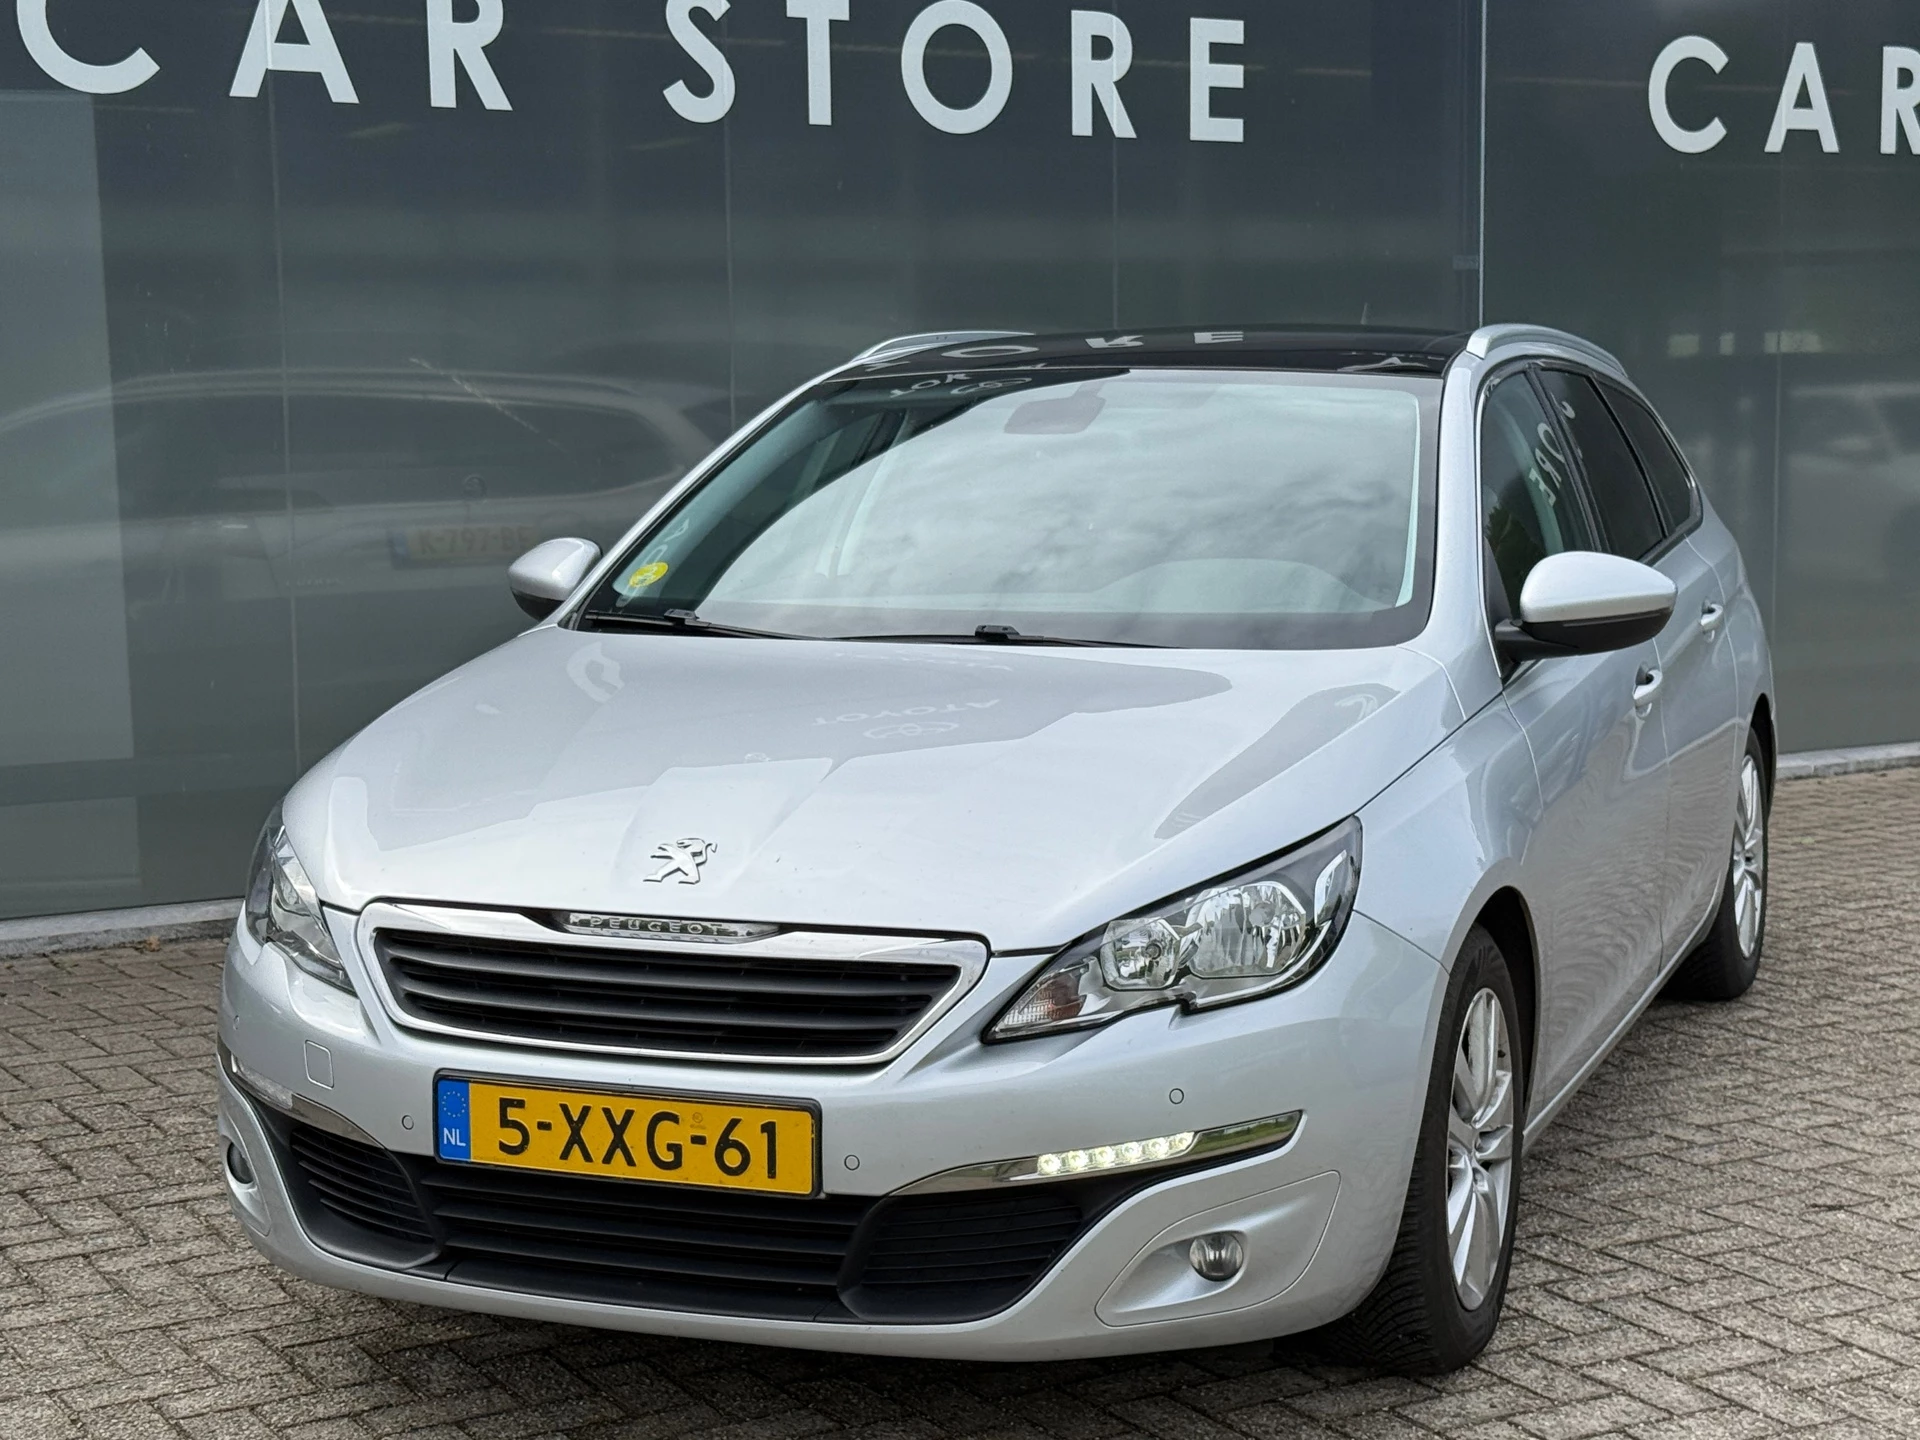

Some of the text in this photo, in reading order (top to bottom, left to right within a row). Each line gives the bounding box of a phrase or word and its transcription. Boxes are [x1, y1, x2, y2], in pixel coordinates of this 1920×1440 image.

[16, 0, 1244, 142] CAR STORE
[1648, 35, 1920, 155] CAR
[590, 915, 723, 936] PEUGEOT
[443, 1127, 466, 1148] NL
[498, 1096, 777, 1180] 5-XXG-61
